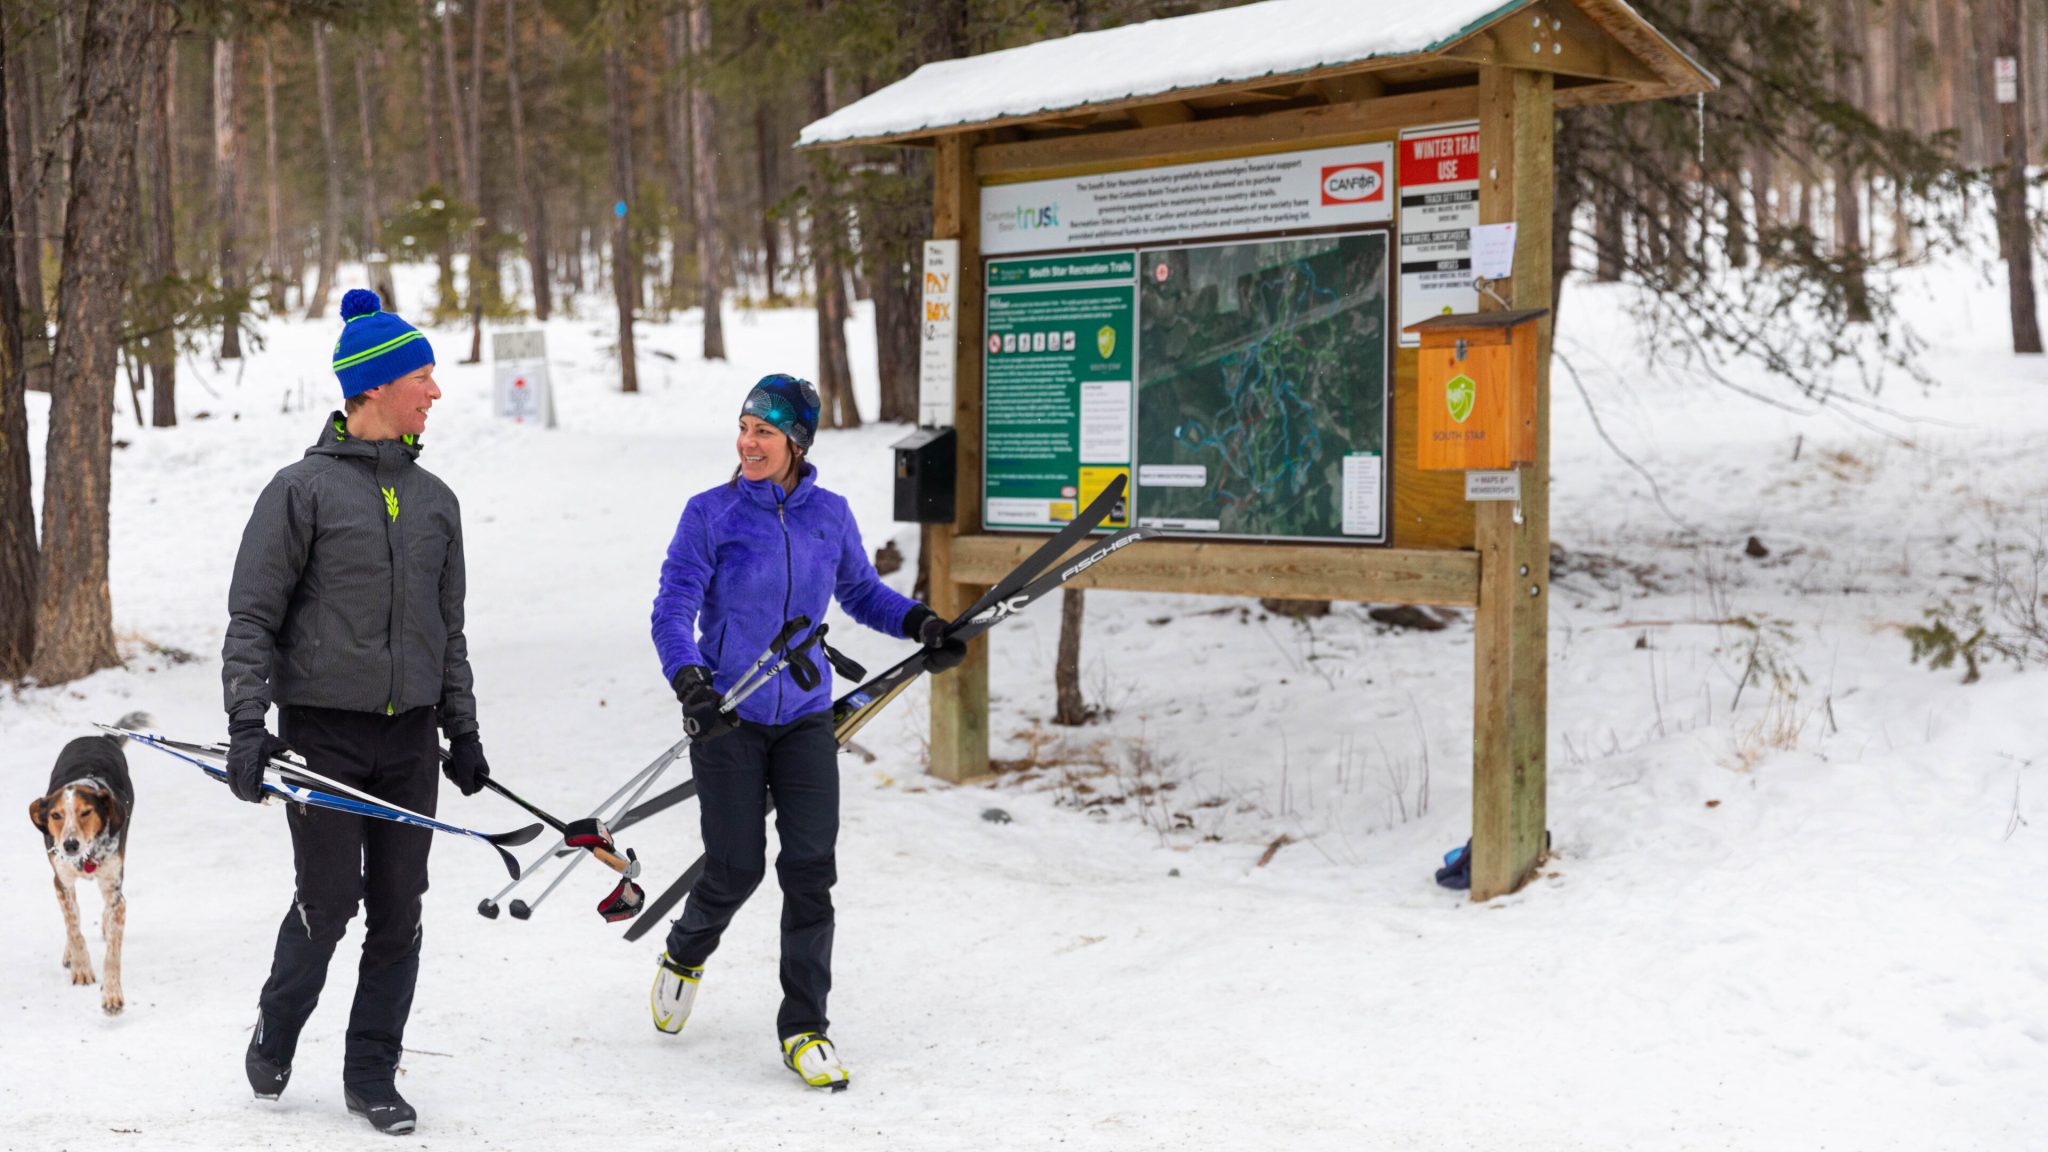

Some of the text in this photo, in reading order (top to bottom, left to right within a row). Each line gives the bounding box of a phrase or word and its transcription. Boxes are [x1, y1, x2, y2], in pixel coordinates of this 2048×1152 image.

[1414, 135, 1480, 160] WINTER TRAI
[1076, 159, 1302, 191] The South Star Recreation Society gratefully acknowledges financial support
[1329, 175, 1376, 192] CANFOR
[1438, 160, 1458, 180] USE
[1093, 193, 1107, 201] from
[1120, 189, 1147, 200] Columbia
[1148, 187, 1164, 197] Basin
[1165, 185, 1180, 195] Trust
[1181, 183, 1198, 193] which
[1200, 182, 1210, 191] has
[1211, 179, 1235, 190] allowed
[1253, 175, 1281, 187] purchase
[1070, 218, 1100, 229] Recreation
[1101, 217, 1114, 226] Sites
[1116, 215, 1126, 225] and
[1127, 213, 1143, 224] Trails
[1155, 210, 1175, 221] Canfor
[1176, 209, 1188, 219] and
[1189, 206, 1219, 217] individual
[1220, 203, 1248, 214] members
[1258, 202, 1269, 211] our
[1270, 199, 1292, 210] society
[1293, 198, 1309, 207] have
[1098, 205, 1127, 216] grooming
[1127, 200, 1159, 212] equipment
[1170, 195, 1206, 207] maintaining
[1207, 194, 1223, 203] cross
[1224, 191, 1248, 202] country
[1250, 188, 1259, 198] ski
[1015, 201, 1060, 232] trust
[1068, 231, 1094, 242] provided
[1095, 228, 1123, 239] additional
[1124, 226, 1141, 236] funds
[1150, 222, 1177, 235] complete
[1178, 221, 1190, 231] this
[1190, 219, 1218, 232] purchase
[1219, 217, 1231, 227] and
[1232, 215, 1261, 227] construct
[1262, 214, 1273, 224] the
[1274, 211, 1299, 224] parking
[1028, 267, 1050, 279] South
[1052, 265, 1067, 277] Star
[1068, 263, 1109, 276] Recreation
[1110, 260, 1132, 273] Trails
[1432, 431, 1486, 442] SOUTH STAR
[1061, 532, 1144, 582] FISCHER
